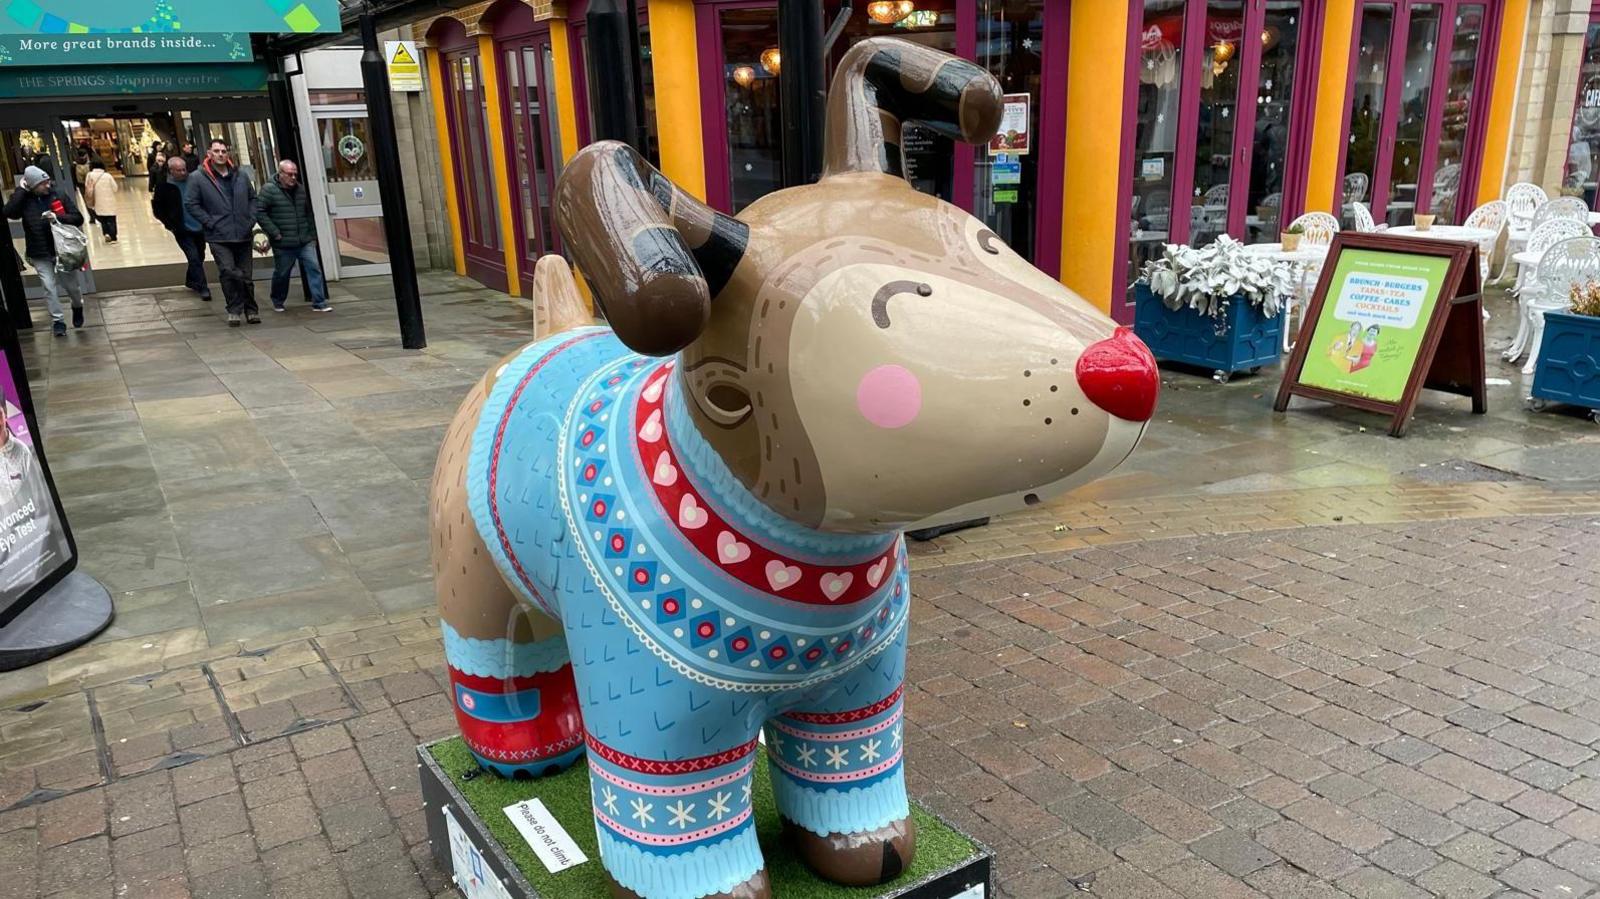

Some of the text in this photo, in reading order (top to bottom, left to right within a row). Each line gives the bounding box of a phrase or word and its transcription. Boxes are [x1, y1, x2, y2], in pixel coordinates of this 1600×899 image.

[19, 36, 216, 52] More great brands inside...
[17, 74, 220, 88] THE SPRINGS shopping centre
[1349, 277, 1422, 291] BRUNCH BURGERS
[1360, 287, 1406, 297] TAPAS TEA
[1350, 293, 1410, 306] COFFEE CAKES
[1355, 302, 1399, 313] COCKTAILS
[0, 498, 36, 534] vanced
[0, 533, 16, 553] Eye
[15, 517, 38, 538] Test
[518, 803, 538, 826] Please
[534, 825, 546, 835] do
[541, 834, 557, 847] not
